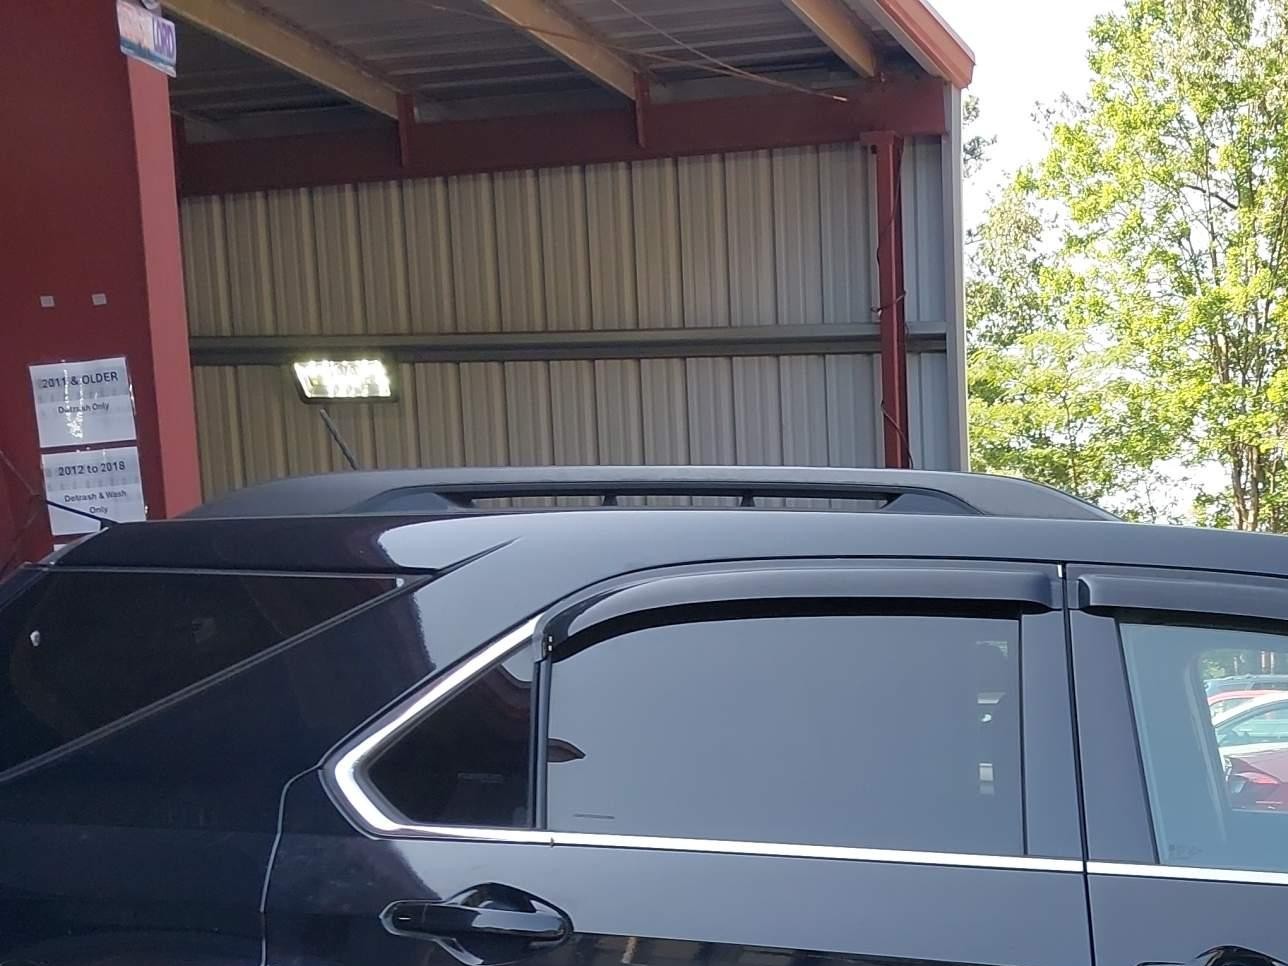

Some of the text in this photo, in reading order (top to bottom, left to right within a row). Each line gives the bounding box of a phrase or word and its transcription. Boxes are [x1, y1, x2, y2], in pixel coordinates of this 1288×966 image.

[42, 371, 118, 388] 2011 & OLDER
[92, 402, 109, 413] Only
[59, 461, 125, 476] 2012 to 2018
[64, 490, 127, 502] Detrash & Wash
[89, 505, 108, 514] Only
